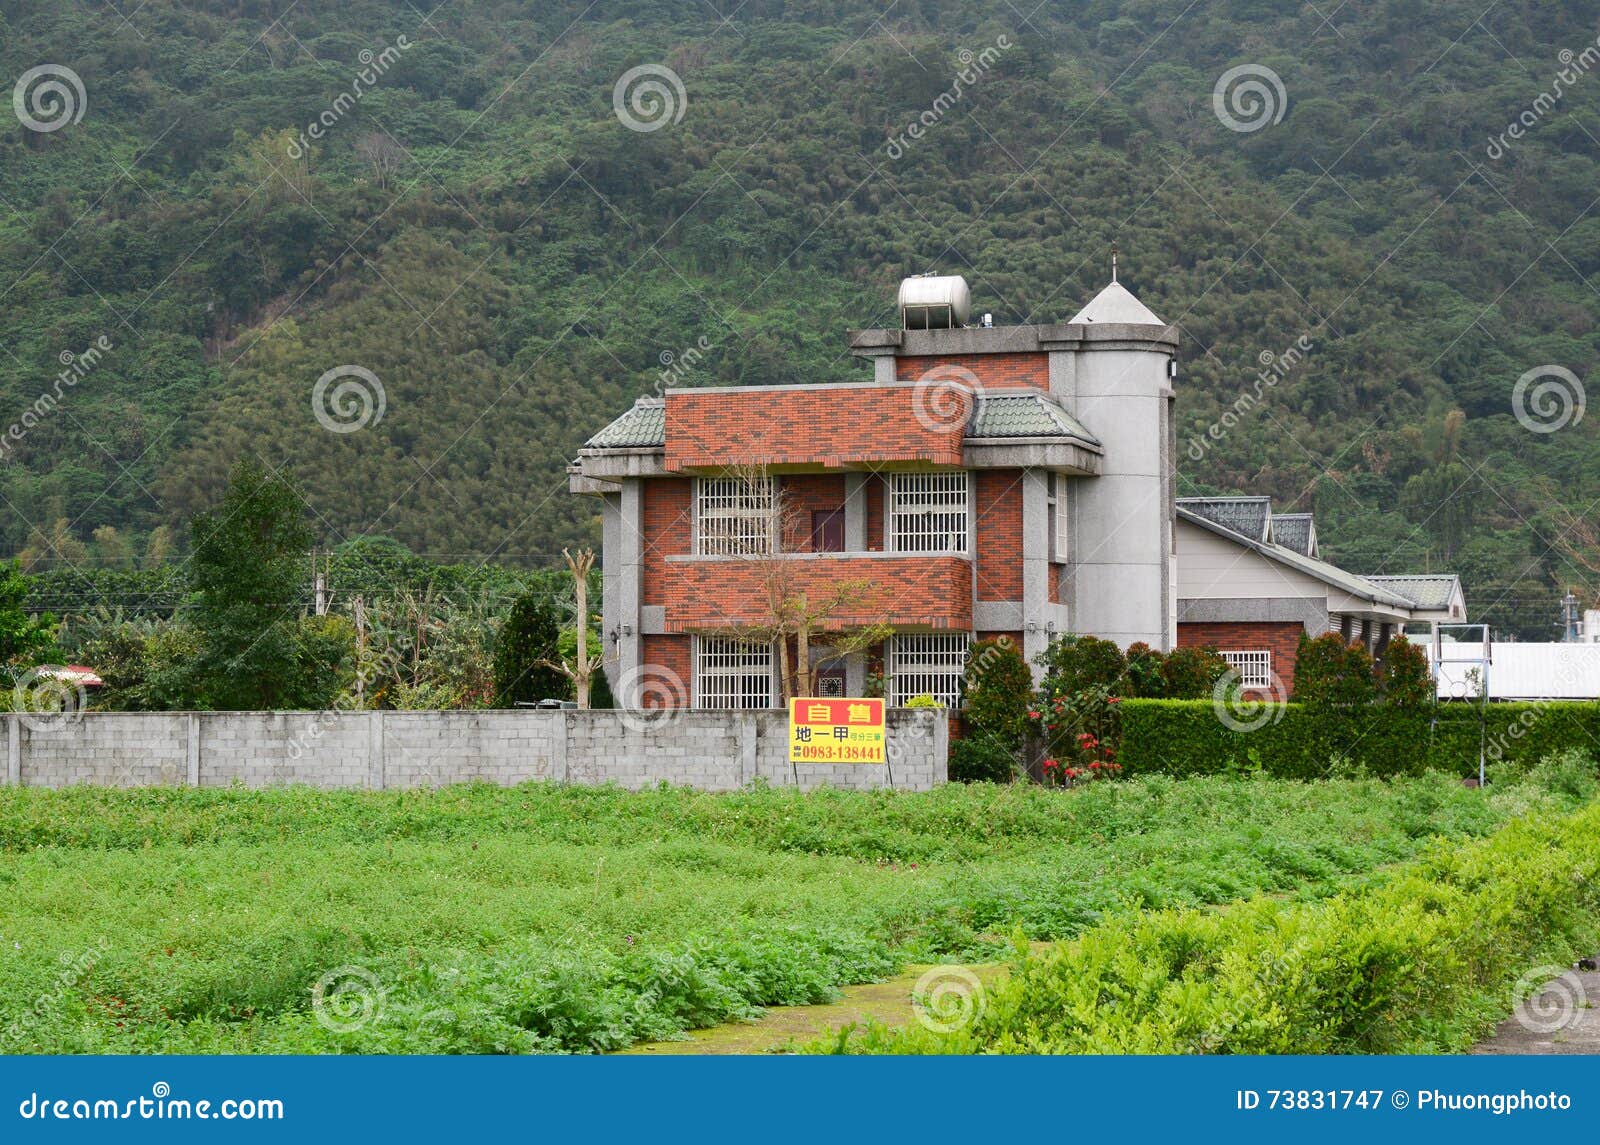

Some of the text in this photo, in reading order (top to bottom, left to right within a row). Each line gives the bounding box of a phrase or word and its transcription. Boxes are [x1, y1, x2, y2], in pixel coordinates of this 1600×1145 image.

[807, 703, 871, 722] 自售
[795, 726, 848, 742] 地一甲
[802, 745, 881, 759] 0983-138441
